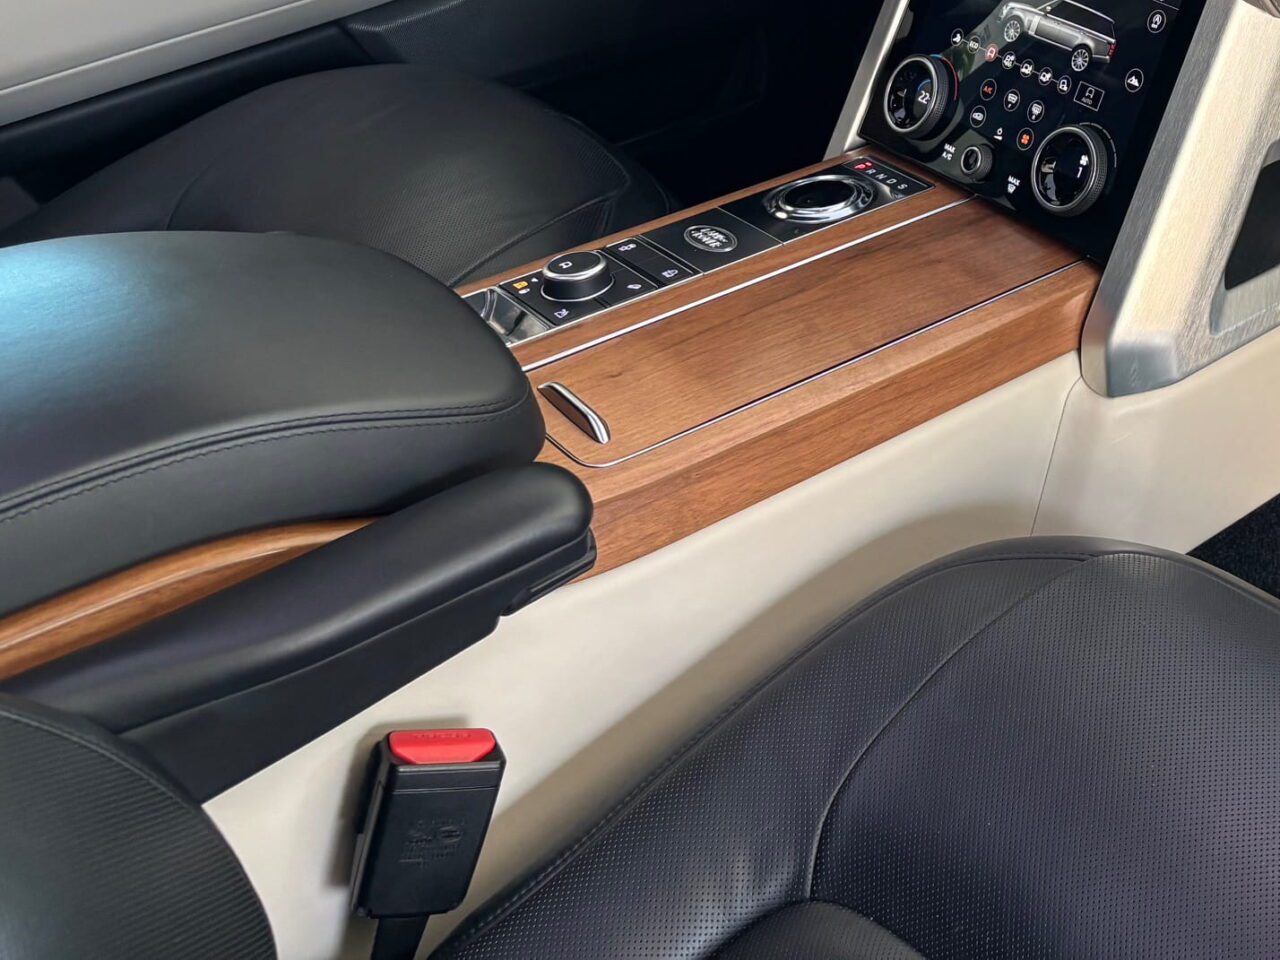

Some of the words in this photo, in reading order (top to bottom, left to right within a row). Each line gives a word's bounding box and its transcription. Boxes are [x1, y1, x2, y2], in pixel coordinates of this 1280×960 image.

[943, 143, 956, 154] MAX
[941, 151, 953, 161] A/C
[1077, 166, 1083, 178] 1
[1007, 175, 1021, 187] MAX
